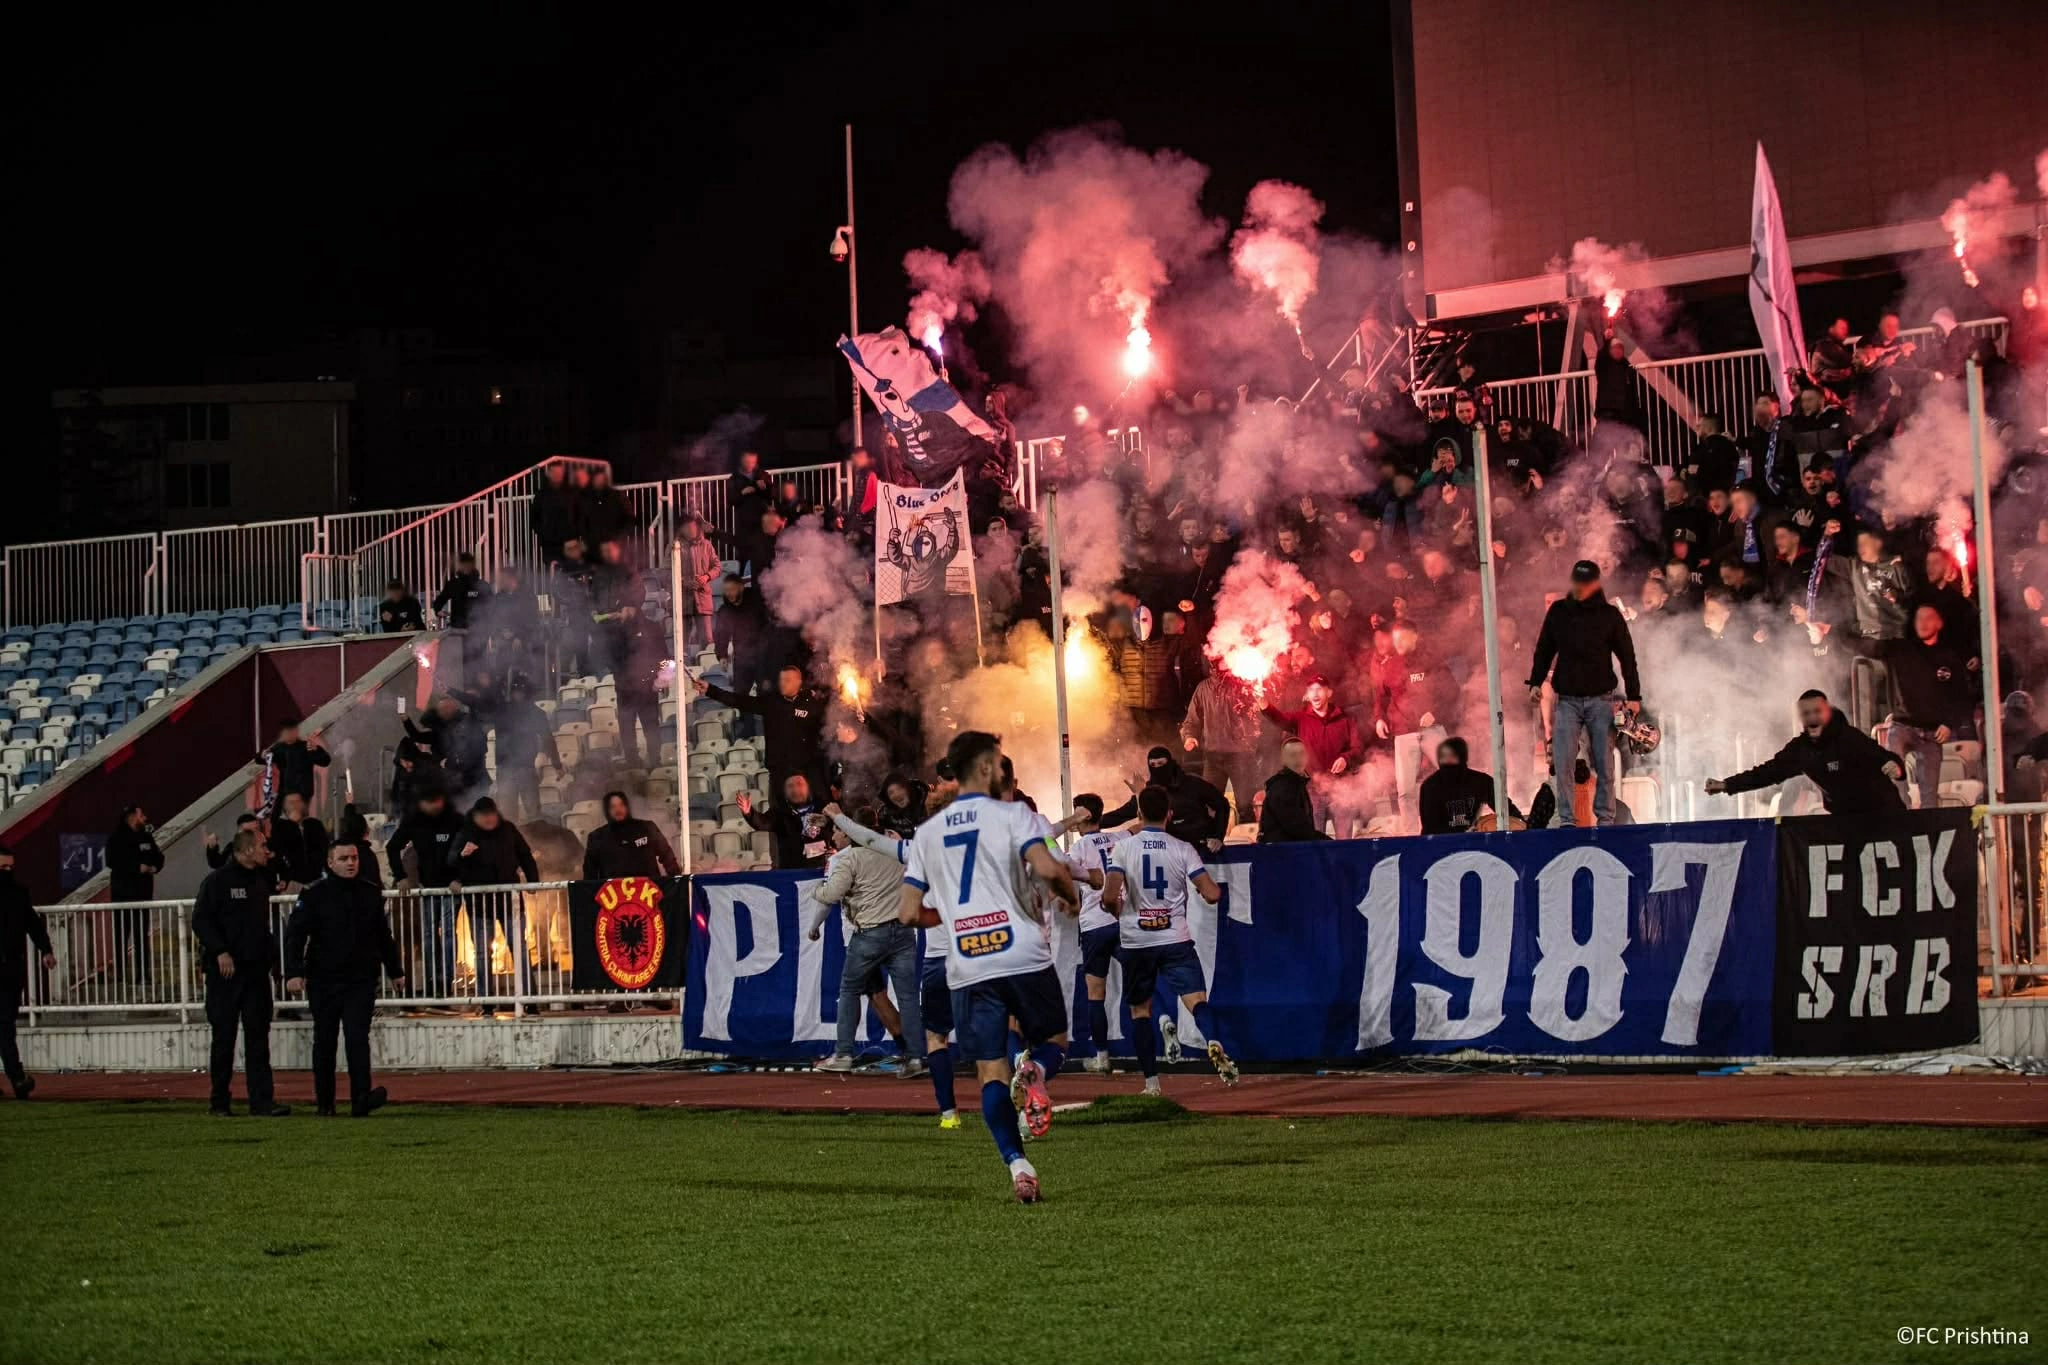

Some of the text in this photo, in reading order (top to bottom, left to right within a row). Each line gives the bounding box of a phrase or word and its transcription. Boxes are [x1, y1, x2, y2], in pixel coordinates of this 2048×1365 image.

[896, 494, 925, 508] Blue
[945, 811, 977, 827] VELIU
[943, 829, 979, 904] 7
[1142, 854, 1168, 900] 4
[1808, 829, 1956, 918] FCK
[600, 877, 658, 910] UÇK
[599, 916, 610, 962] USHTRIA
[956, 912, 1008, 930] BOROTALCO
[960, 930, 1009, 951] RIO
[1355, 840, 1748, 1051] 1987
[1797, 938, 1951, 1019] SRB
